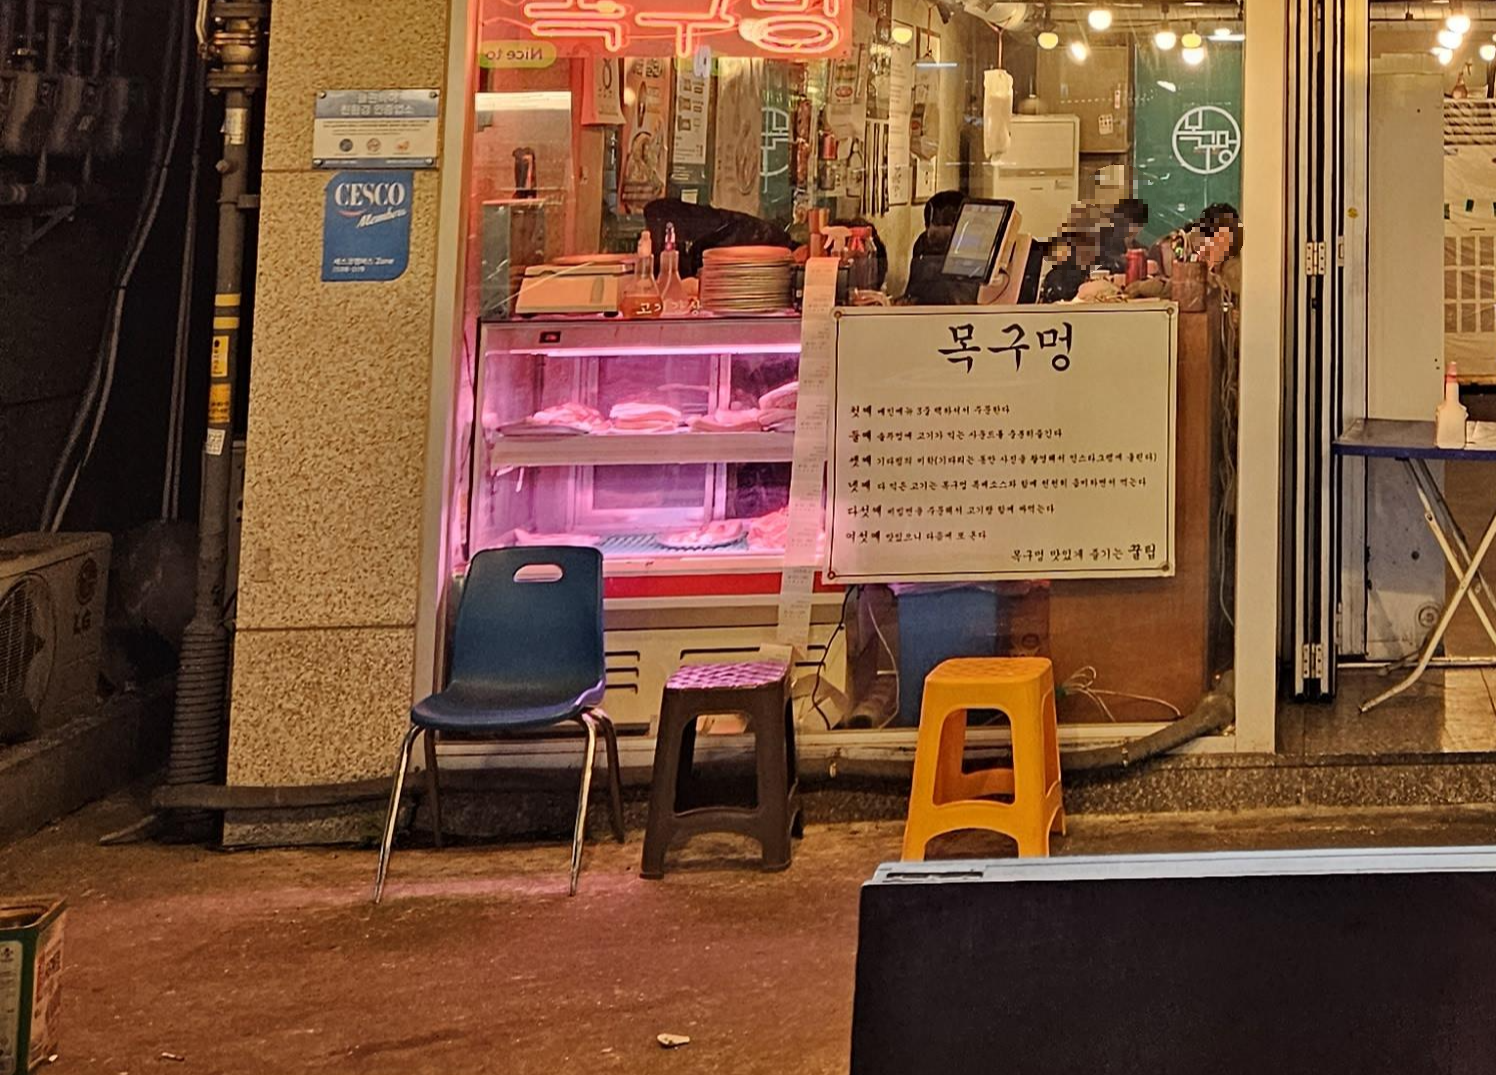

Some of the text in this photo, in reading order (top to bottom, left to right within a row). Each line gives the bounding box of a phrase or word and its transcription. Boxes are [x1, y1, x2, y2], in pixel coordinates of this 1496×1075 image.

[334, 182, 406, 207] CESCO
[937, 321, 1073, 374] 목구멍
[916, 430, 944, 441] 고기가
